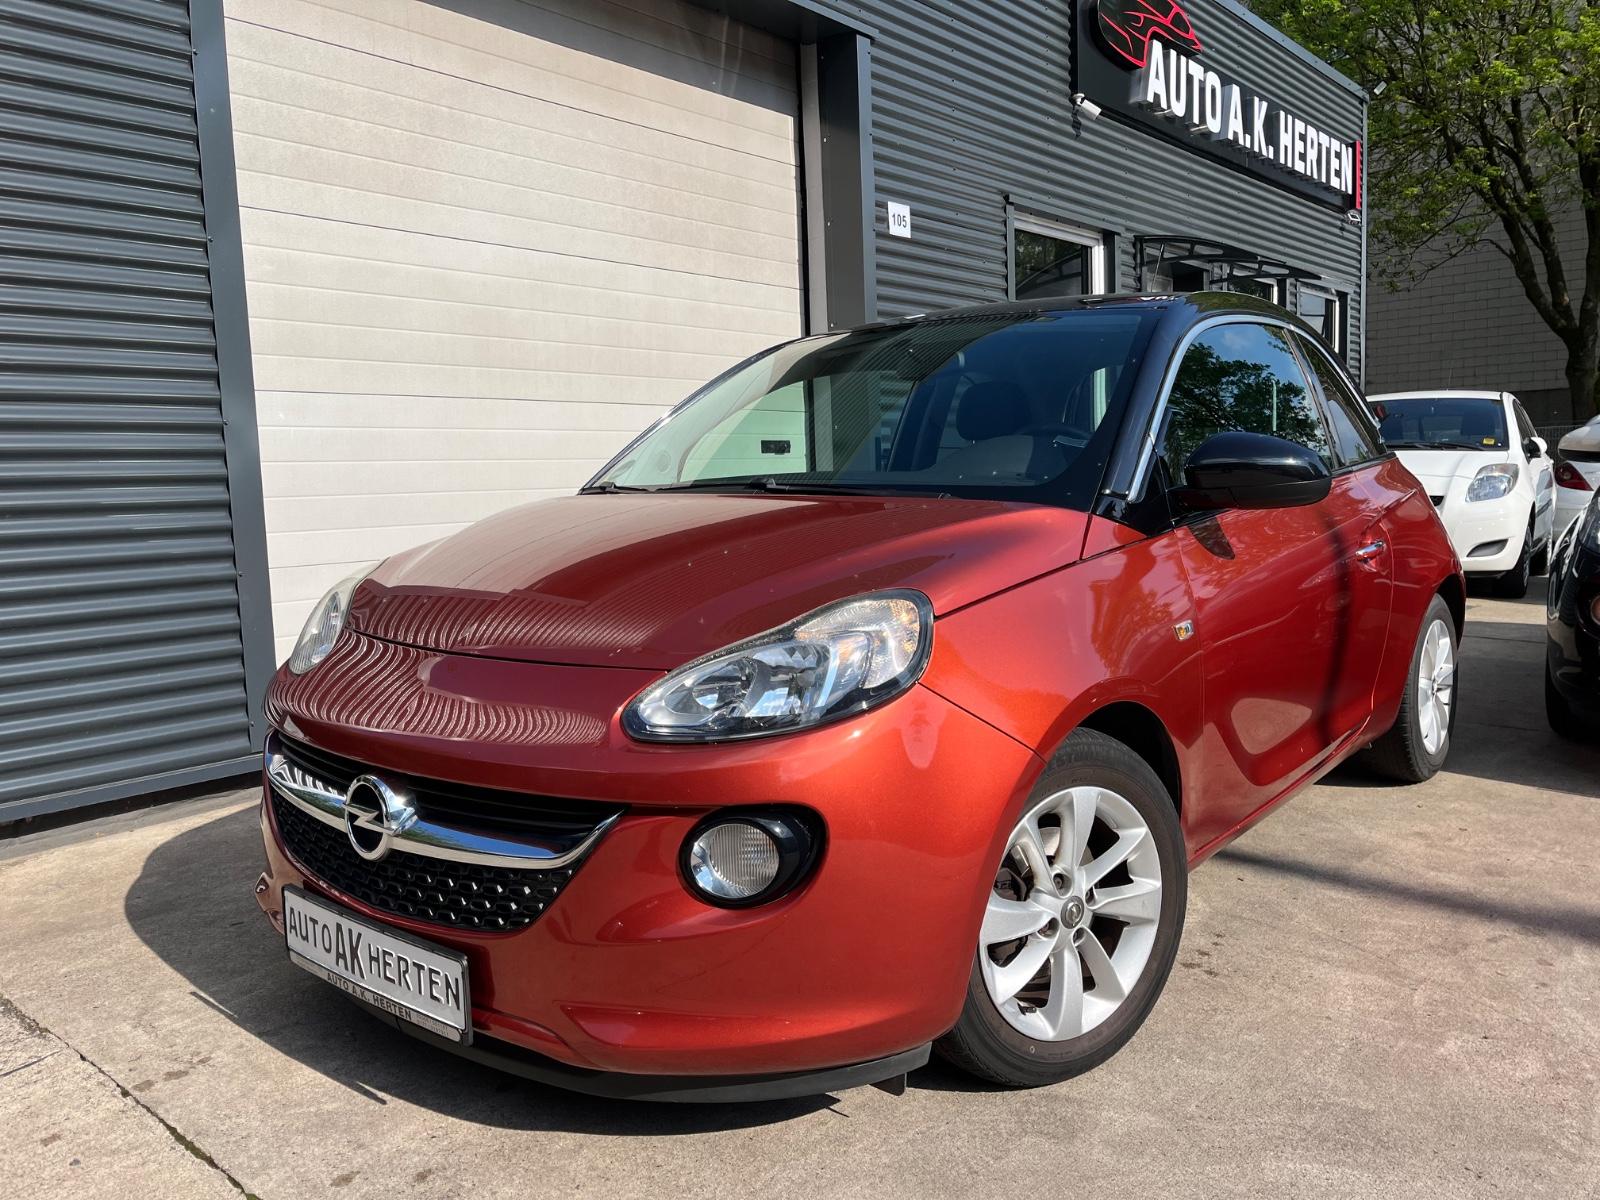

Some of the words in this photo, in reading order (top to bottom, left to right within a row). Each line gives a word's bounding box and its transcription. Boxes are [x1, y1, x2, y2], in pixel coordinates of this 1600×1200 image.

[1147, 39, 1222, 134] AUTO
[1279, 110, 1353, 195] HERTEN
[892, 213, 907, 228] 105
[289, 907, 332, 954] AUTO
[335, 922, 366, 980] AK
[368, 943, 460, 1010] HERTEN
[327, 972, 349, 991] AUTO
[372, 994, 412, 1021] HERTEN
